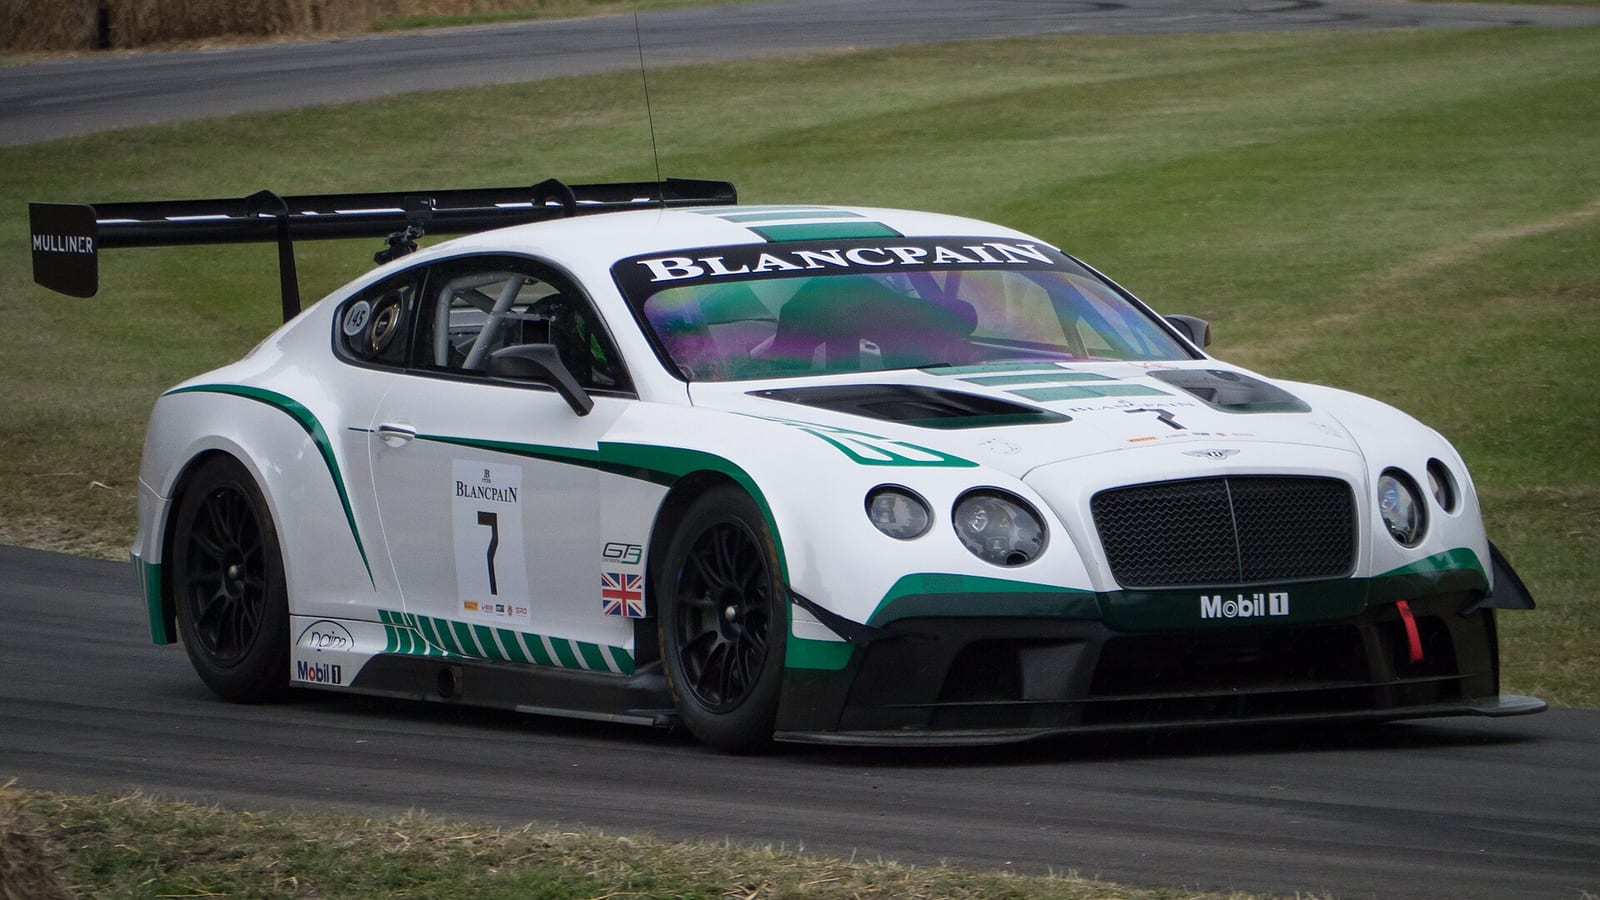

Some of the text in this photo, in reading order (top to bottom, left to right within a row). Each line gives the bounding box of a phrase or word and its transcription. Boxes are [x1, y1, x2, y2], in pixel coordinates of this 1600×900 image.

[33, 234, 94, 254] MULLINER
[637, 243, 1055, 282] BLANCPAIN
[1123, 408, 1188, 430] 7
[456, 480, 518, 503] BLANCPAIN
[477, 510, 498, 595] 7
[602, 542, 642, 565] GT3
[1200, 593, 1265, 618] Mobil
[310, 631, 347, 648] naim
[297, 660, 341, 684] Mobil 1
